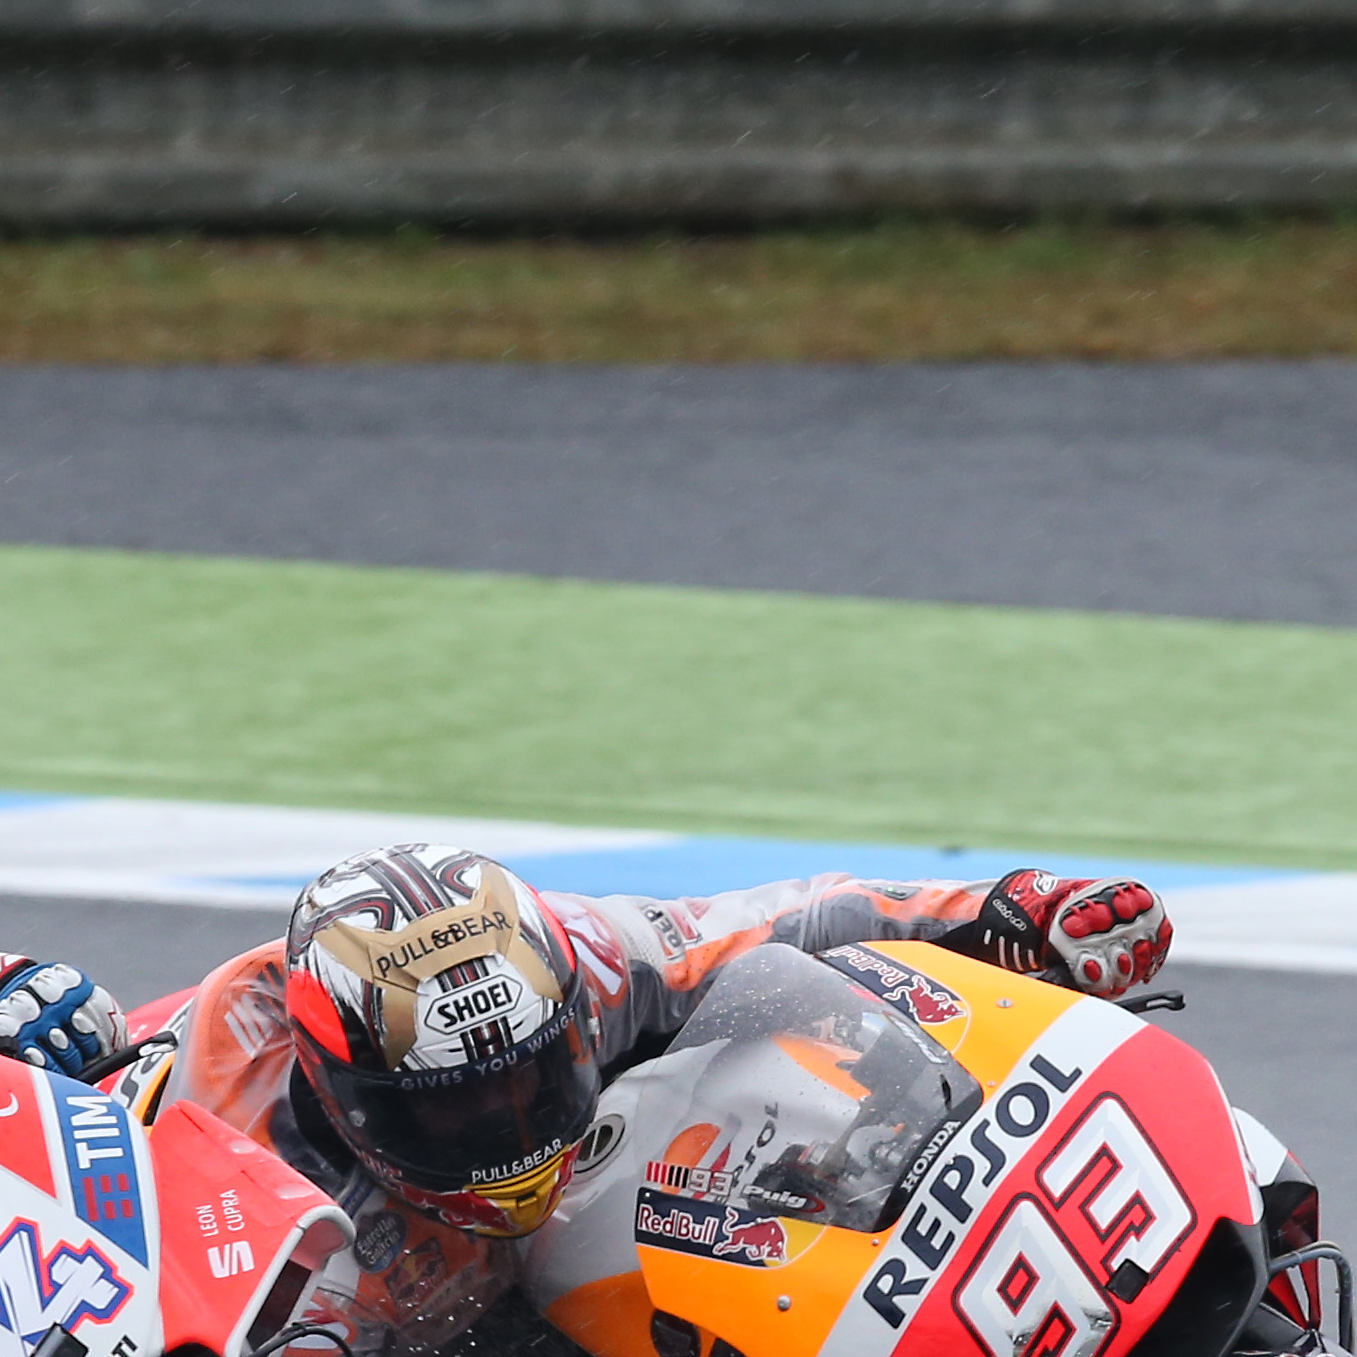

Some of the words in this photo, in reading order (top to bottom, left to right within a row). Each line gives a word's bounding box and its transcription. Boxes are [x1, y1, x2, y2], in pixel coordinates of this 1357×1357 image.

[375, 910, 513, 979] PULL&BEAR
[640, 904, 682, 948] REP
[436, 981, 514, 1031] SHOEI
[401, 1070, 463, 1091] GIVES
[475, 1050, 518, 1076] YOU
[527, 1008, 576, 1054] WINGS
[66, 1094, 126, 1170] TIM
[471, 1137, 563, 1184] PULL&BEAR
[901, 1119, 961, 1193] HONDA
[688, 1167, 734, 1197] 93
[742, 1184, 808, 1208] Puig
[862, 1054, 1082, 1329] REPSOL
[201, 1204, 219, 1238] LEON
[220, 1189, 244, 1233] CUPRA
[637, 1203, 678, 1238] Red
[677, 1211, 720, 1246] Bull
